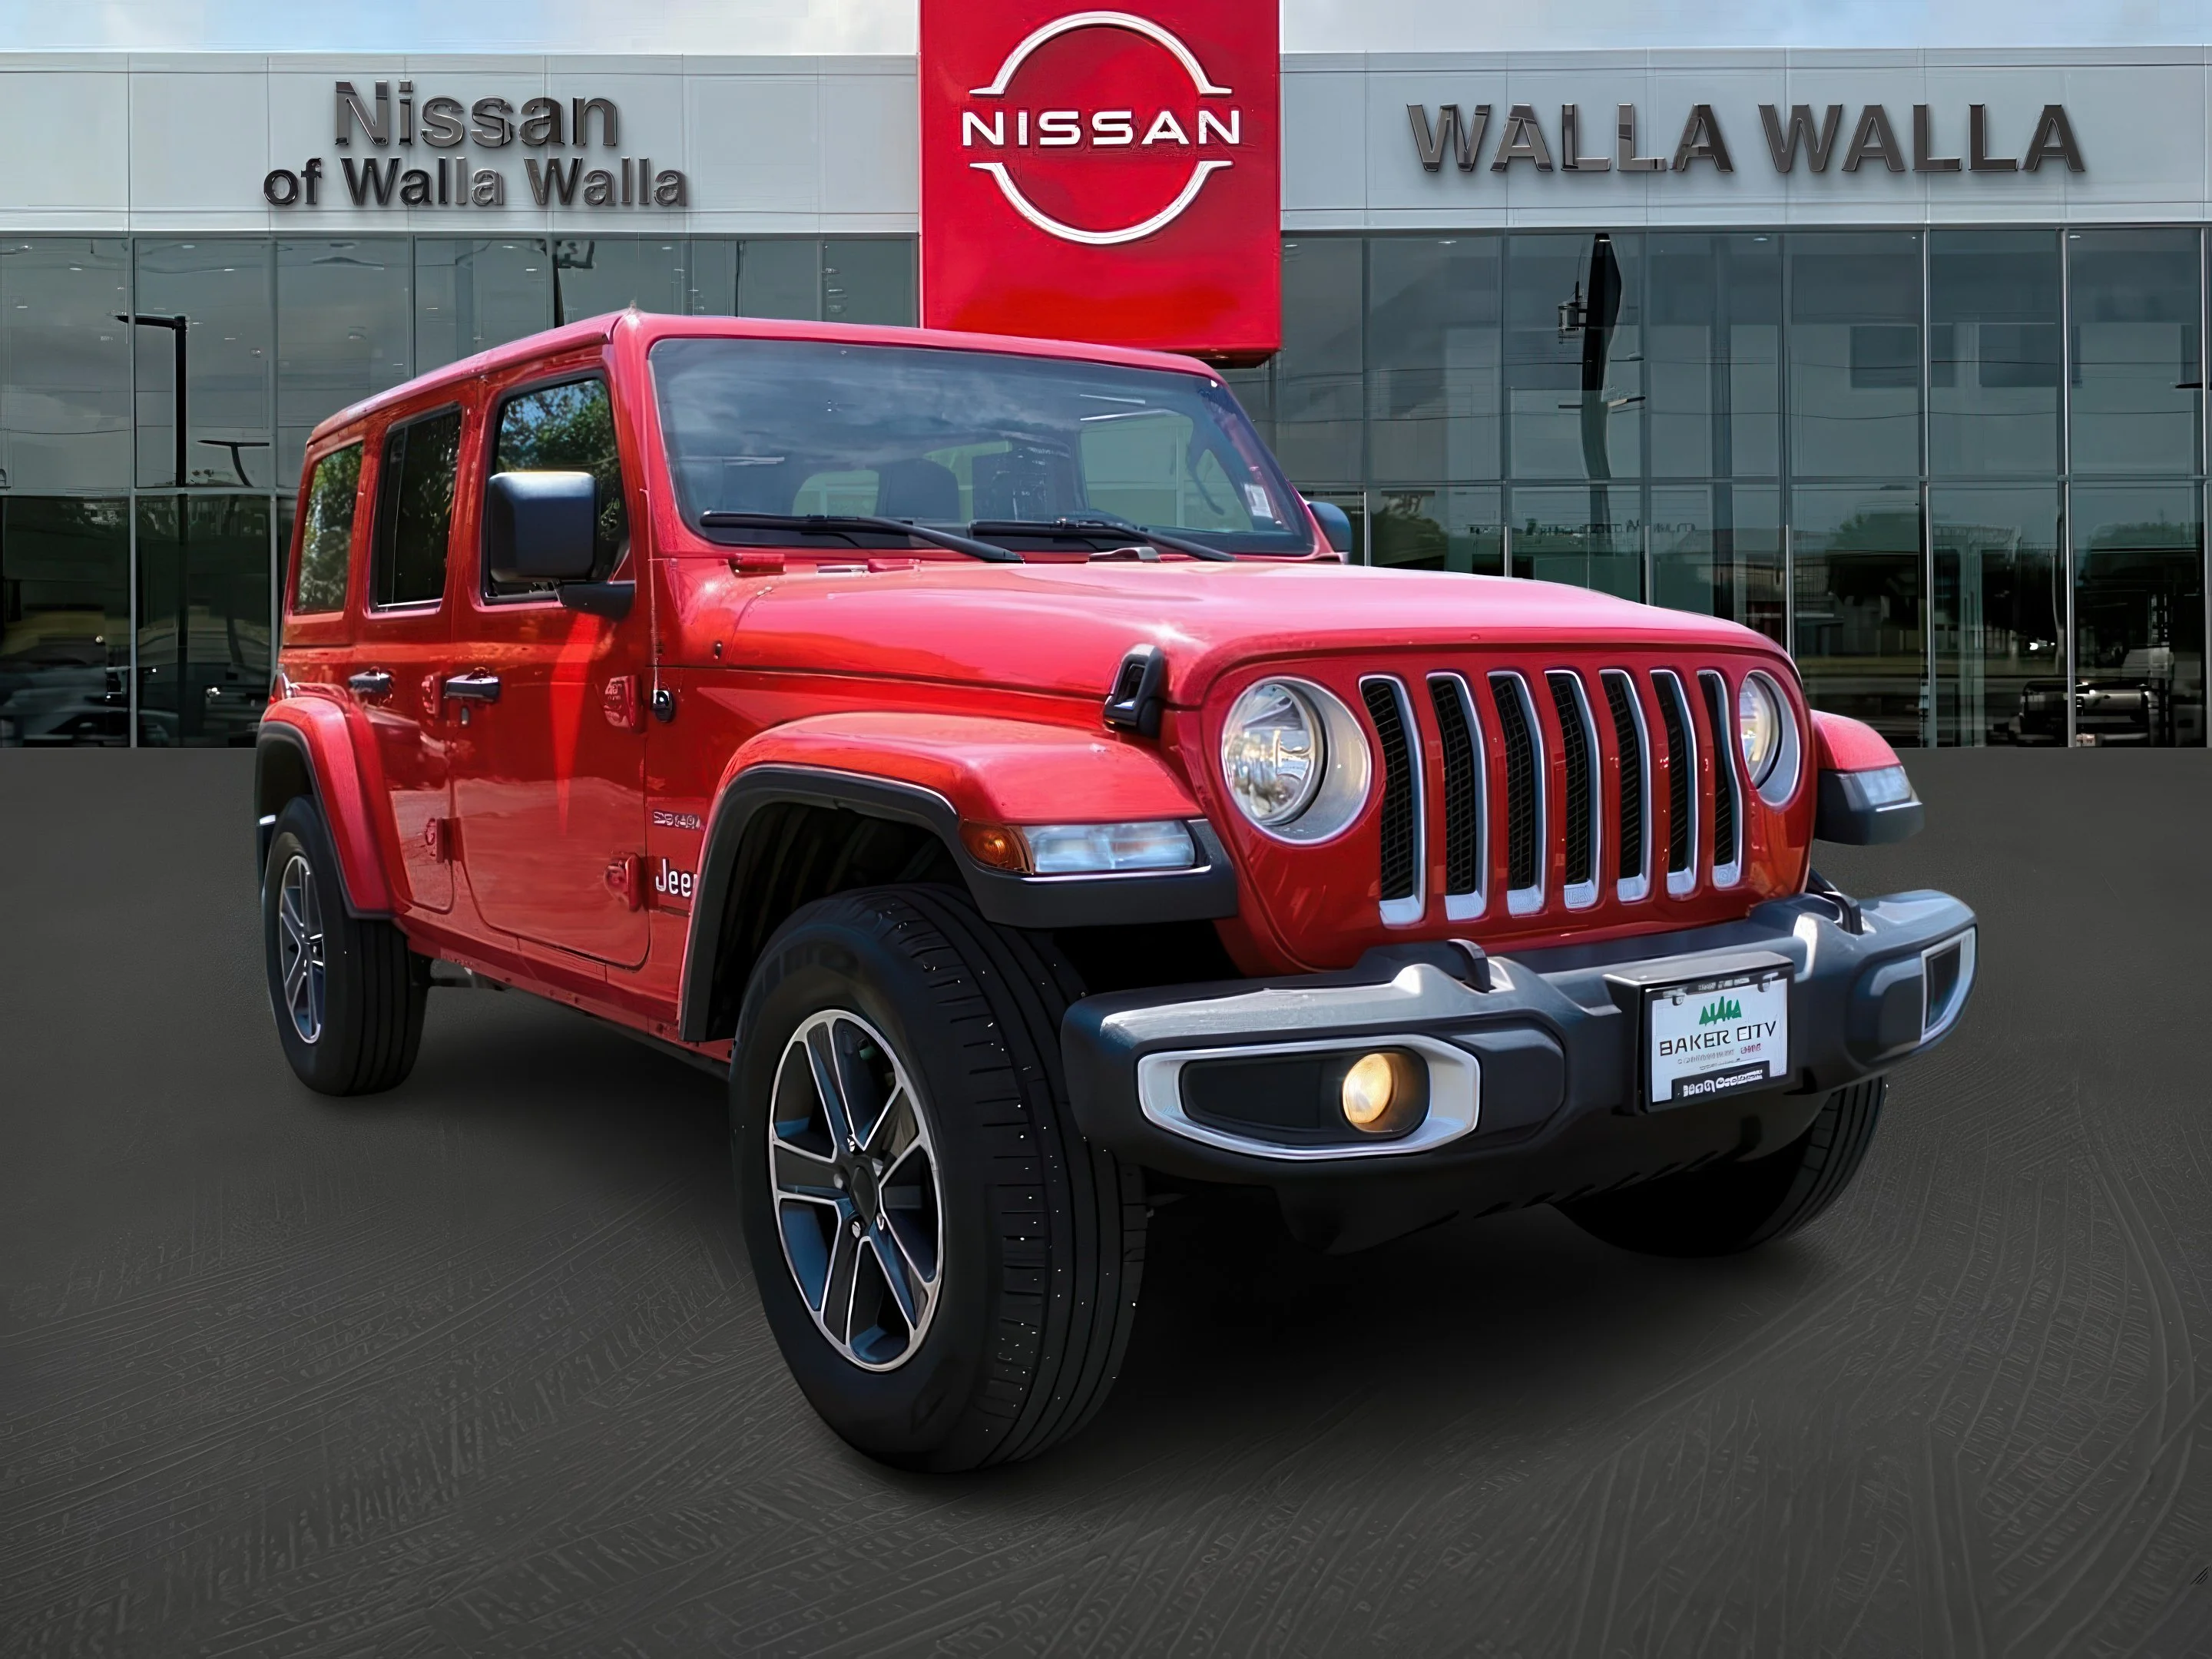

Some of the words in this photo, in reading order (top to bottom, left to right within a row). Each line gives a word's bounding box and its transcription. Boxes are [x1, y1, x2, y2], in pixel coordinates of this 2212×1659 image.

[334, 79, 618, 147] Nissan
[962, 109, 1240, 147] NISSAN
[1406, 102, 1734, 173] WALLA
[1758, 102, 2086, 173] WALLA
[263, 157, 323, 207] of
[339, 156, 504, 207] Walla
[522, 156, 687, 207] Walla
[656, 858, 697, 897] Jee
[1660, 1029, 1731, 1057] BAKER
